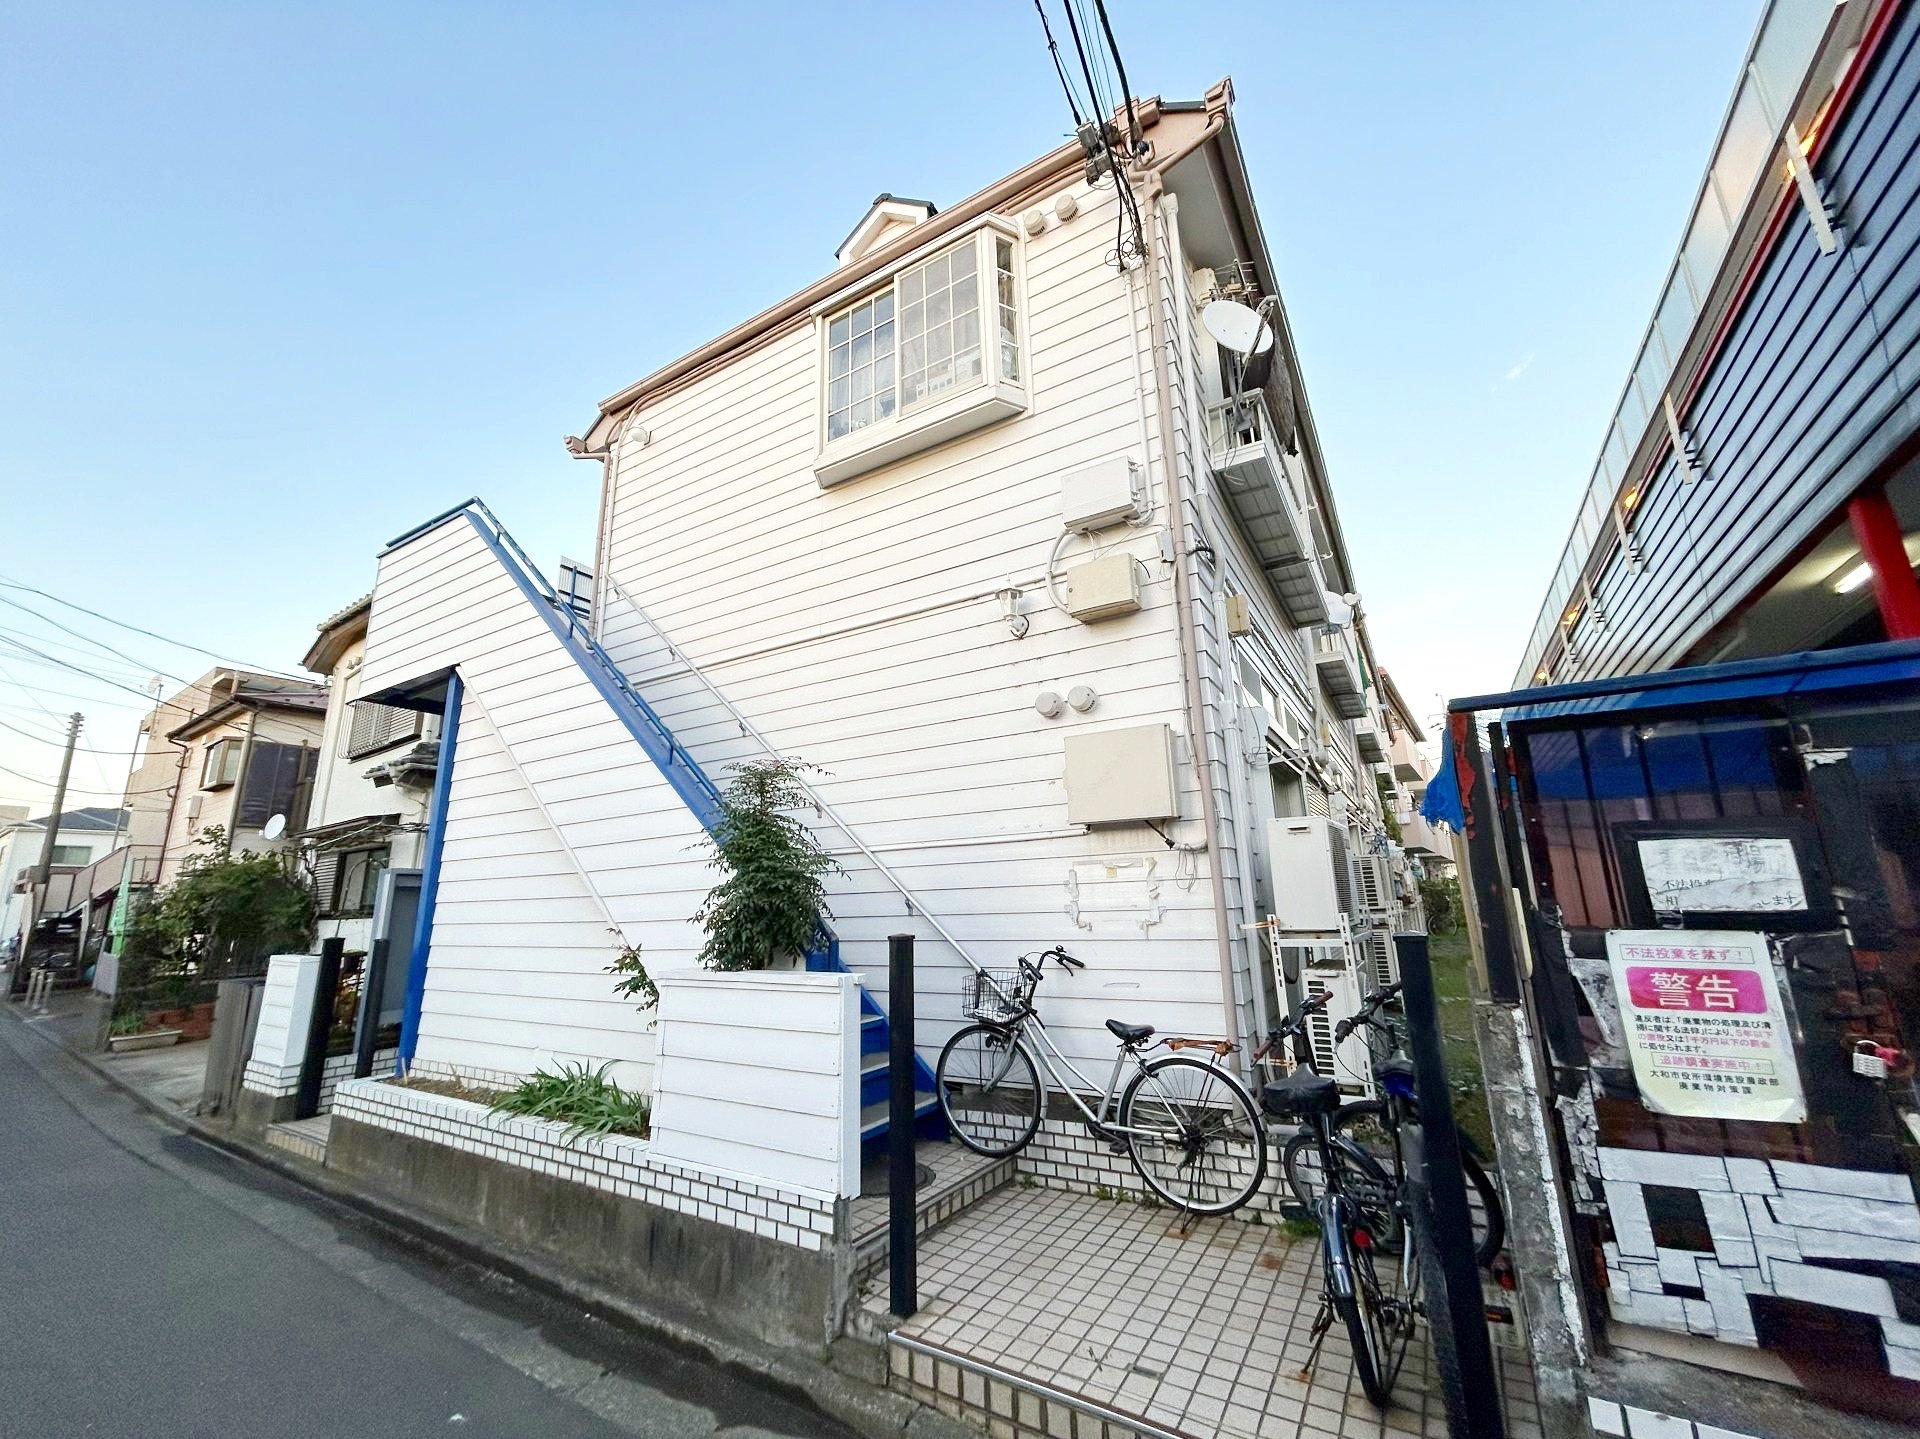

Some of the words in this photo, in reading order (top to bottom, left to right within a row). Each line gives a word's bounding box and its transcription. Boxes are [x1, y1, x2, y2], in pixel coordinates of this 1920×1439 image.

[1649, 972, 1739, 1009] 警告
[1679, 1081, 1753, 1095] 廃棄物対策課
